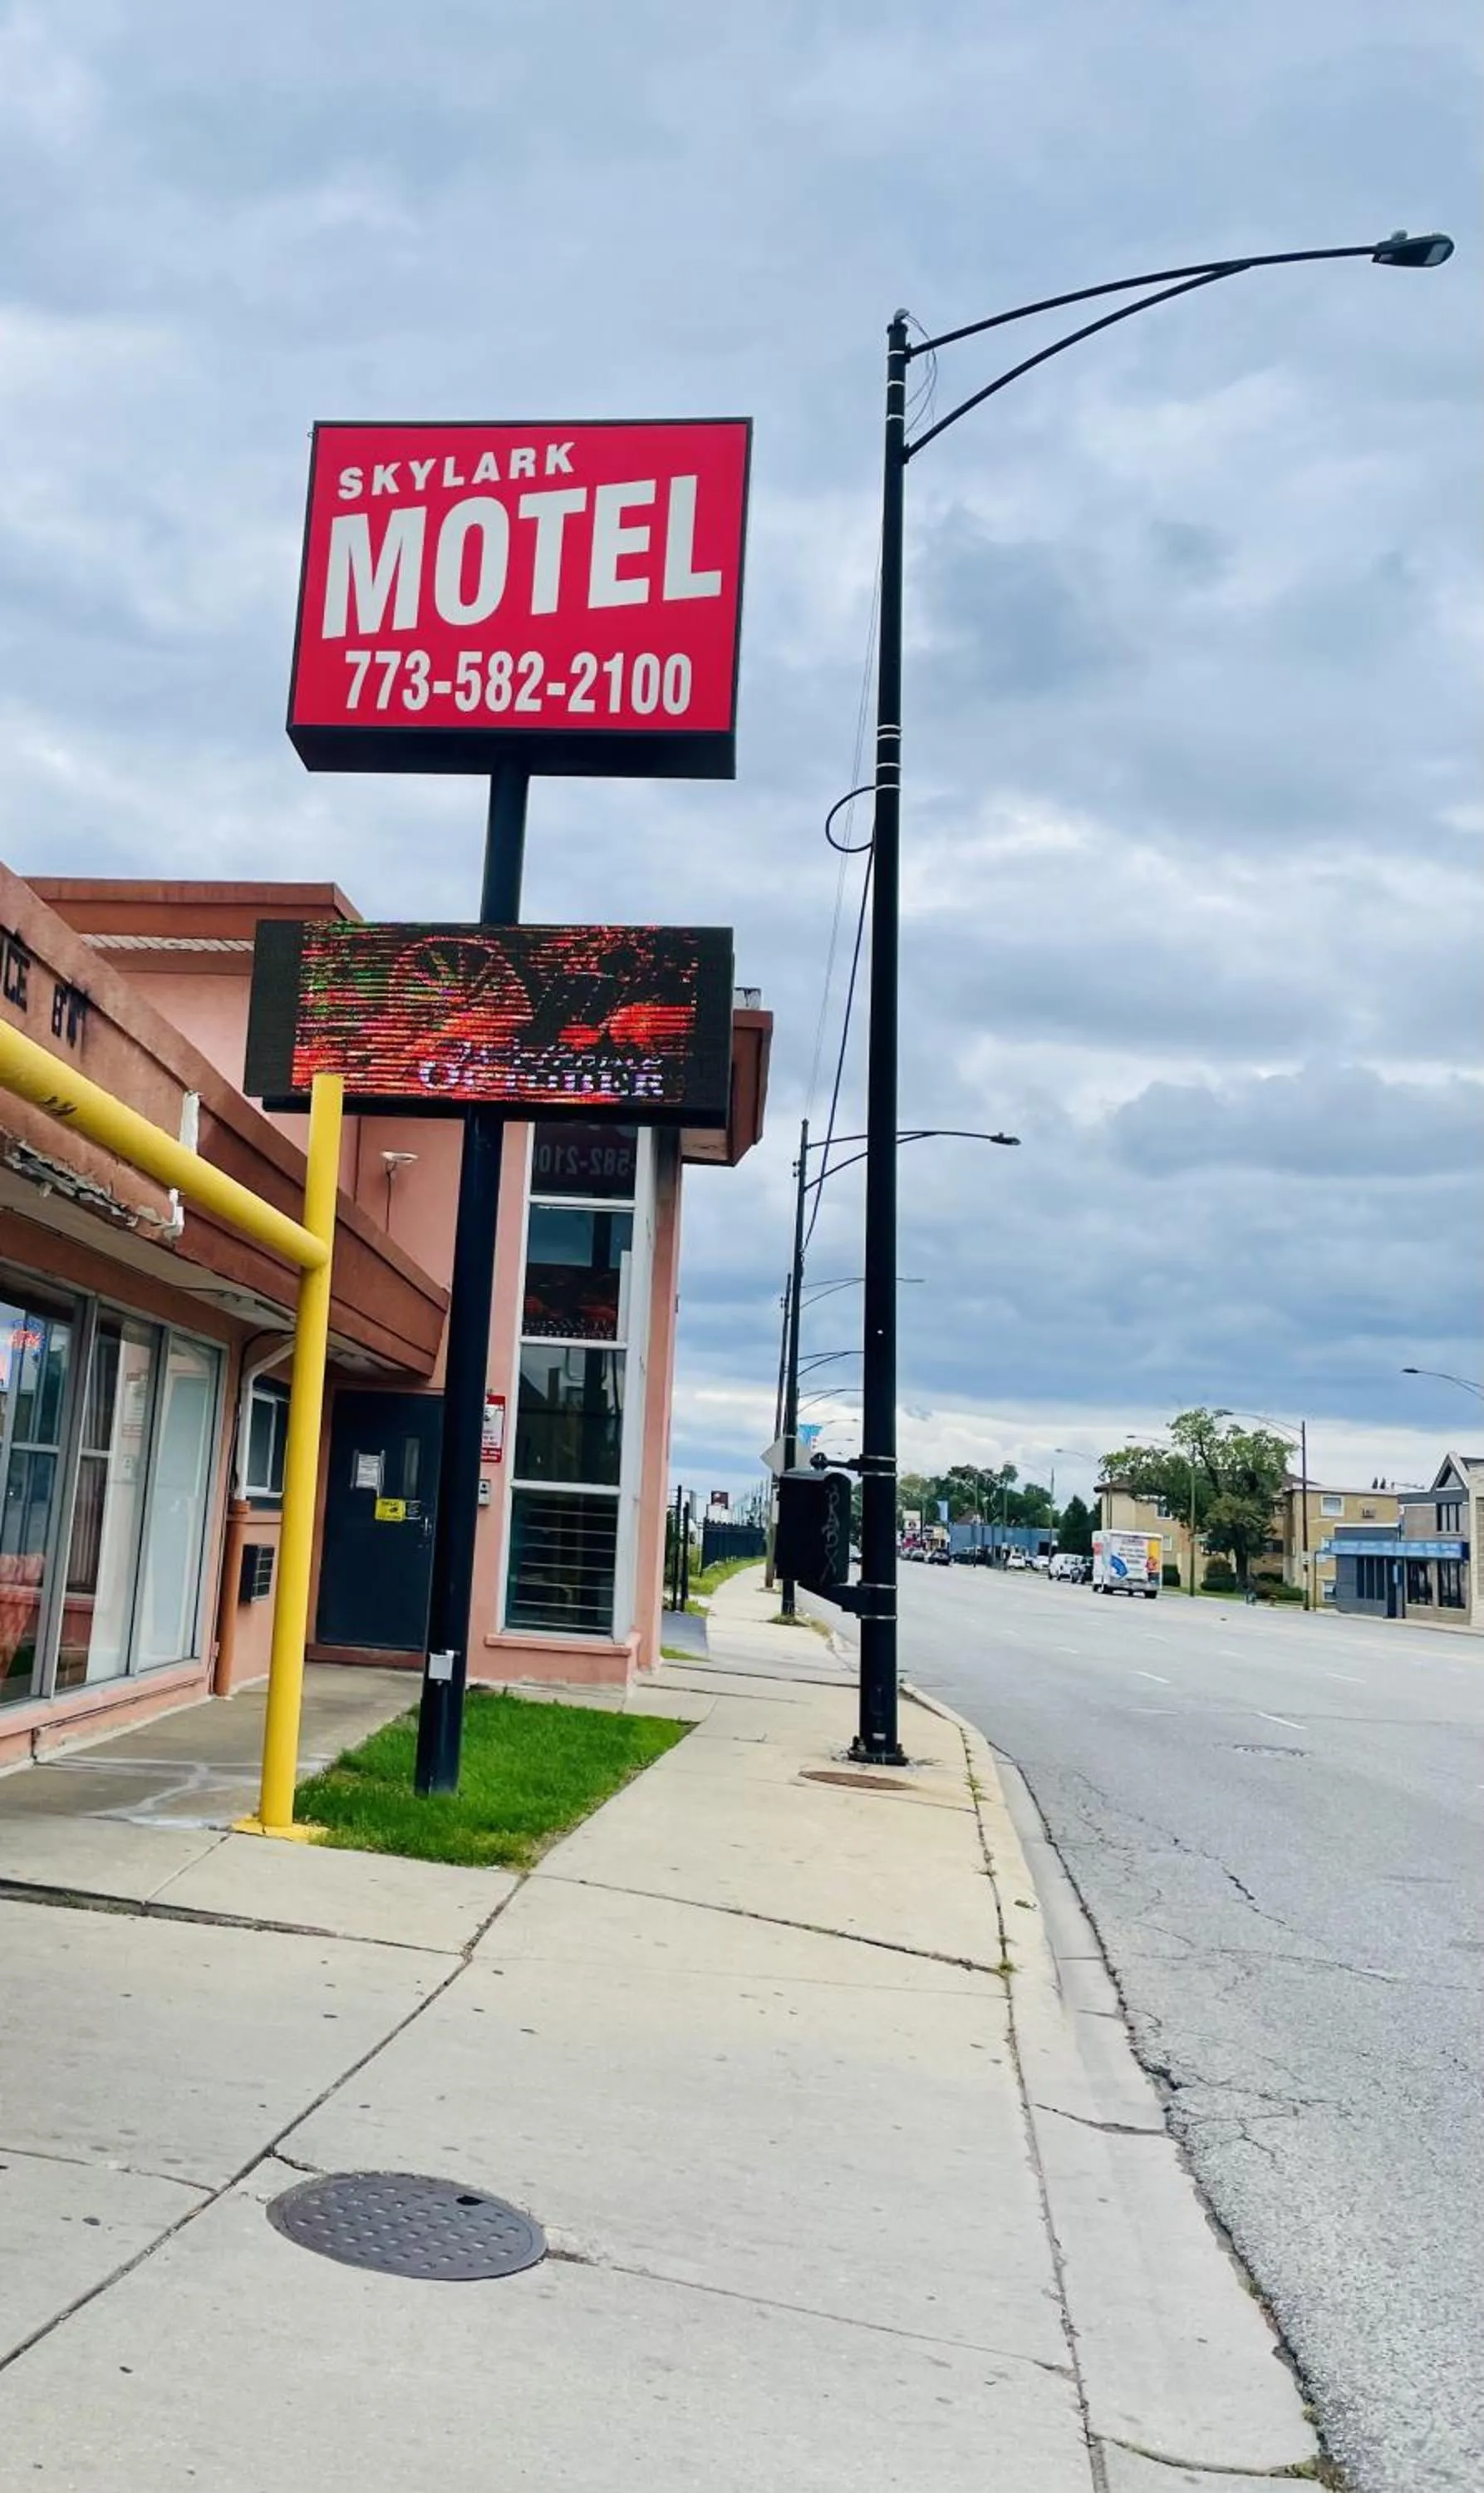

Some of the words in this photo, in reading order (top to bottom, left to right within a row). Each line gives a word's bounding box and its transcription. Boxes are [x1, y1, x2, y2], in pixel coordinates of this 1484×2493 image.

[337, 441, 575, 499] SKYLARK
[322, 475, 722, 639] MOTEL
[344, 650, 693, 715] 773-582-2100
